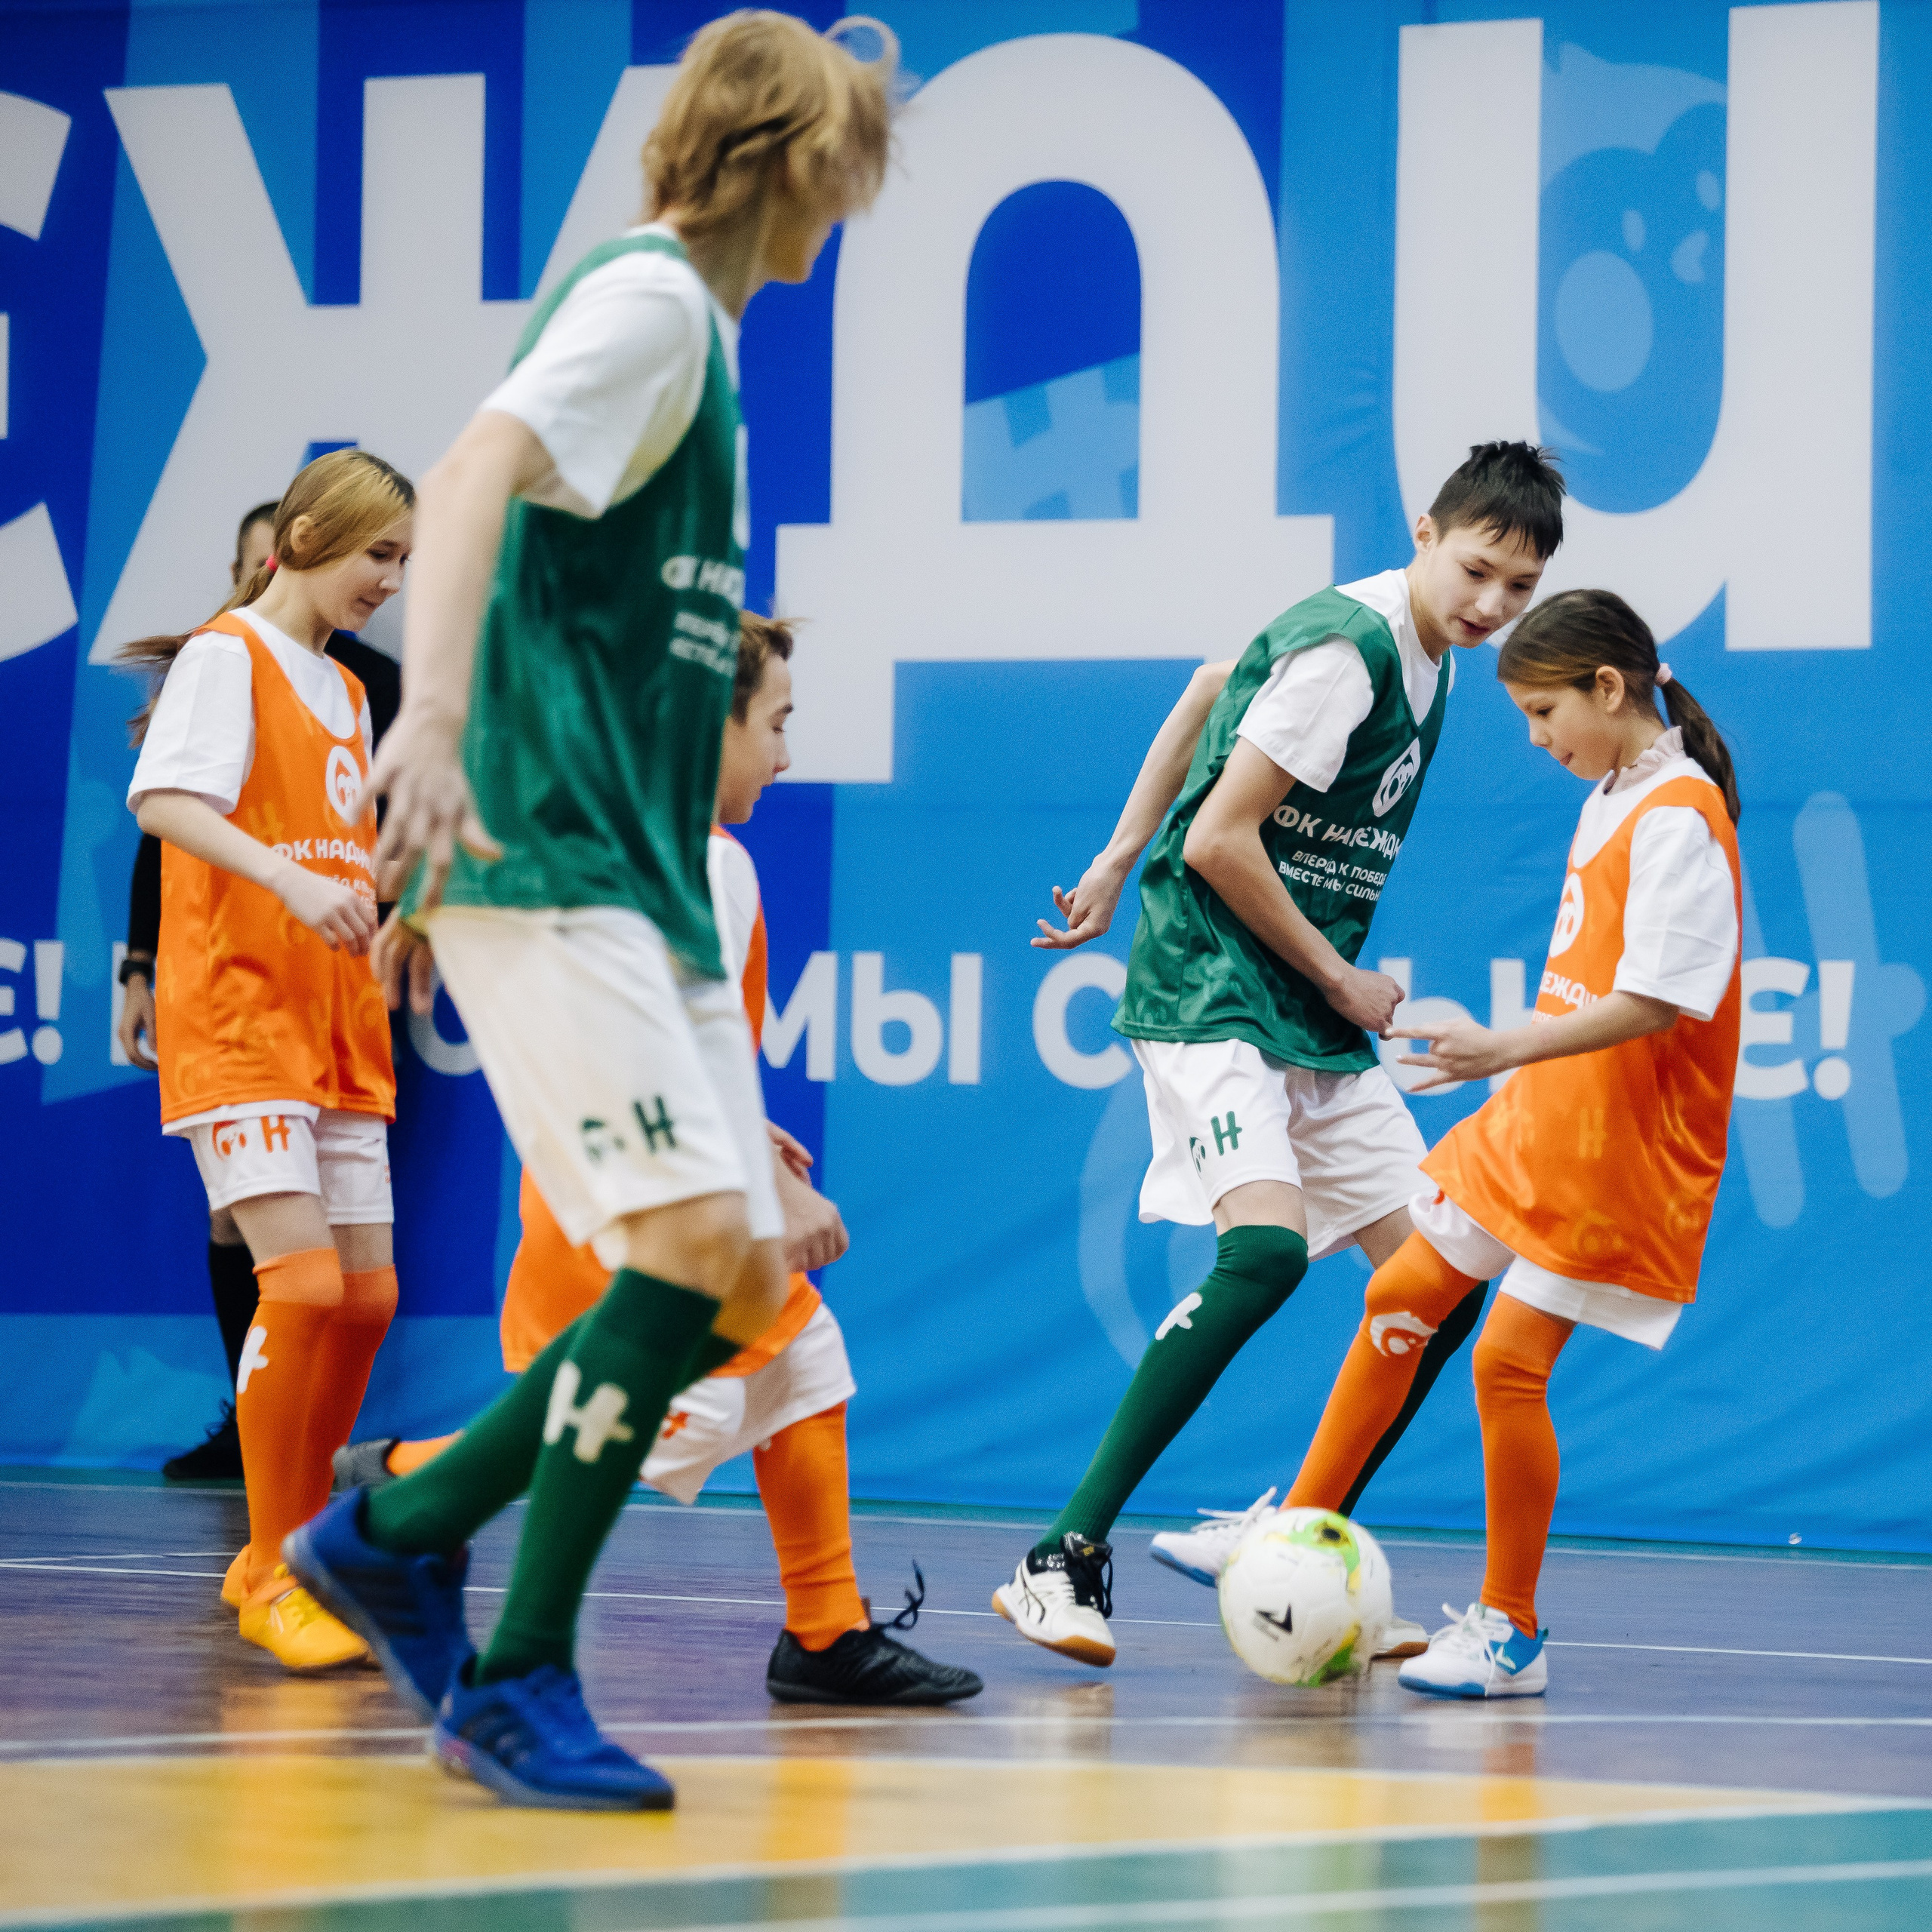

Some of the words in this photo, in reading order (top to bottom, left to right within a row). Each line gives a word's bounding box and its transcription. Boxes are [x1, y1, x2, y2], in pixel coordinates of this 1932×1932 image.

[0, 0, 1881, 783] ЖДИ
[1273, 804, 1322, 838] ФК
[1278, 860, 1324, 888] ВМЕСТЕ
[1323, 878, 1346, 892] МЫ
[1339, 863, 1350, 876] К
[761, 951, 981, 1087] МЫ
